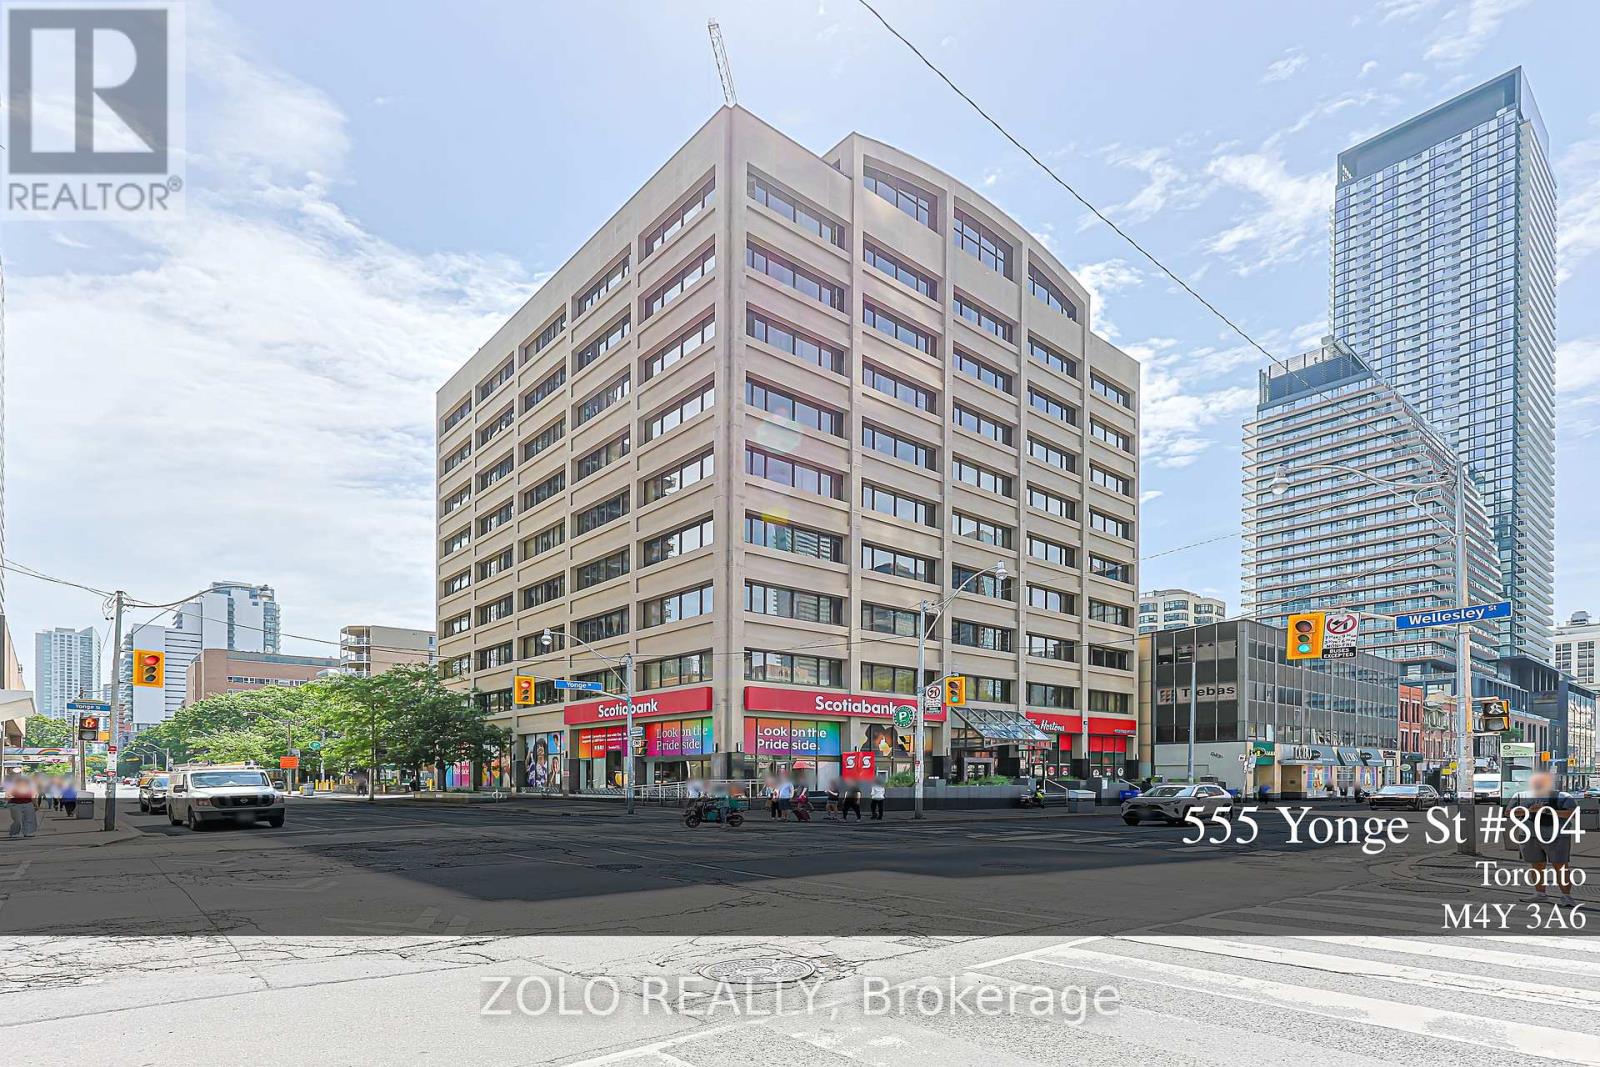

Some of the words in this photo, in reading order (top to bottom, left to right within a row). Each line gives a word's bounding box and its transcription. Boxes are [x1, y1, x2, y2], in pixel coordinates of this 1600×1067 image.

[1409, 608, 1485, 626] Wellesley
[1488, 604, 1497, 612] St
[1181, 686, 1235, 698] Tebas
[815, 696, 897, 716] Scotiabank
[656, 727, 679, 739] Look
[693, 724, 708, 736] the
[757, 725, 788, 737] Look
[791, 729, 806, 738] on
[807, 727, 827, 738] the
[656, 739, 680, 751] Pride
[757, 738, 789, 749] Pride
[791, 739, 821, 751] side.
